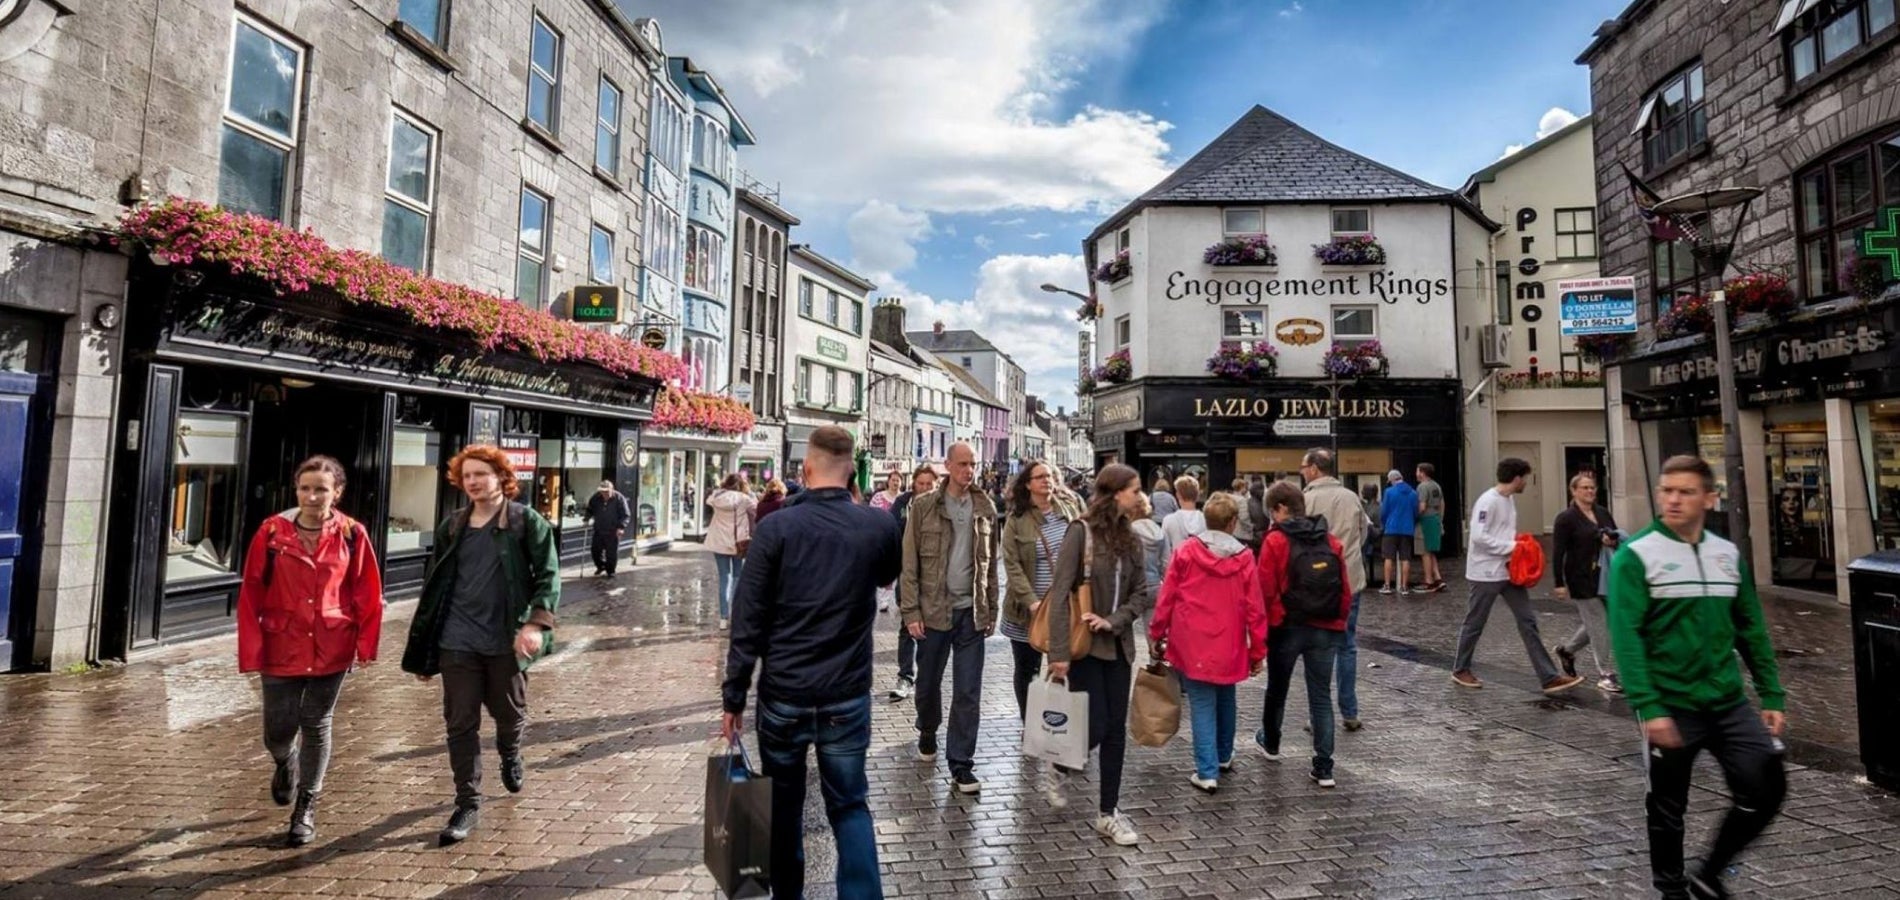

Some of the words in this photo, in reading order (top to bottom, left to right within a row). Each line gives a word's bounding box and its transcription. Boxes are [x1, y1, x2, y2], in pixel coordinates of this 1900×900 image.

[1166, 270, 1360, 304] Engagement
[1368, 269, 1449, 304] Rings
[1577, 295, 1588, 303] TO
[1590, 294, 1603, 302] LET
[576, 307, 615, 317] ROLEX
[1577, 310, 1608, 319] JOYCE
[1572, 318, 1588, 328] 091
[1591, 317, 1625, 326] 564212
[1080, 333, 1088, 416] NEWSTS
[1195, 399, 1269, 417] LAZLO
[1163, 435, 1177, 443] 20
